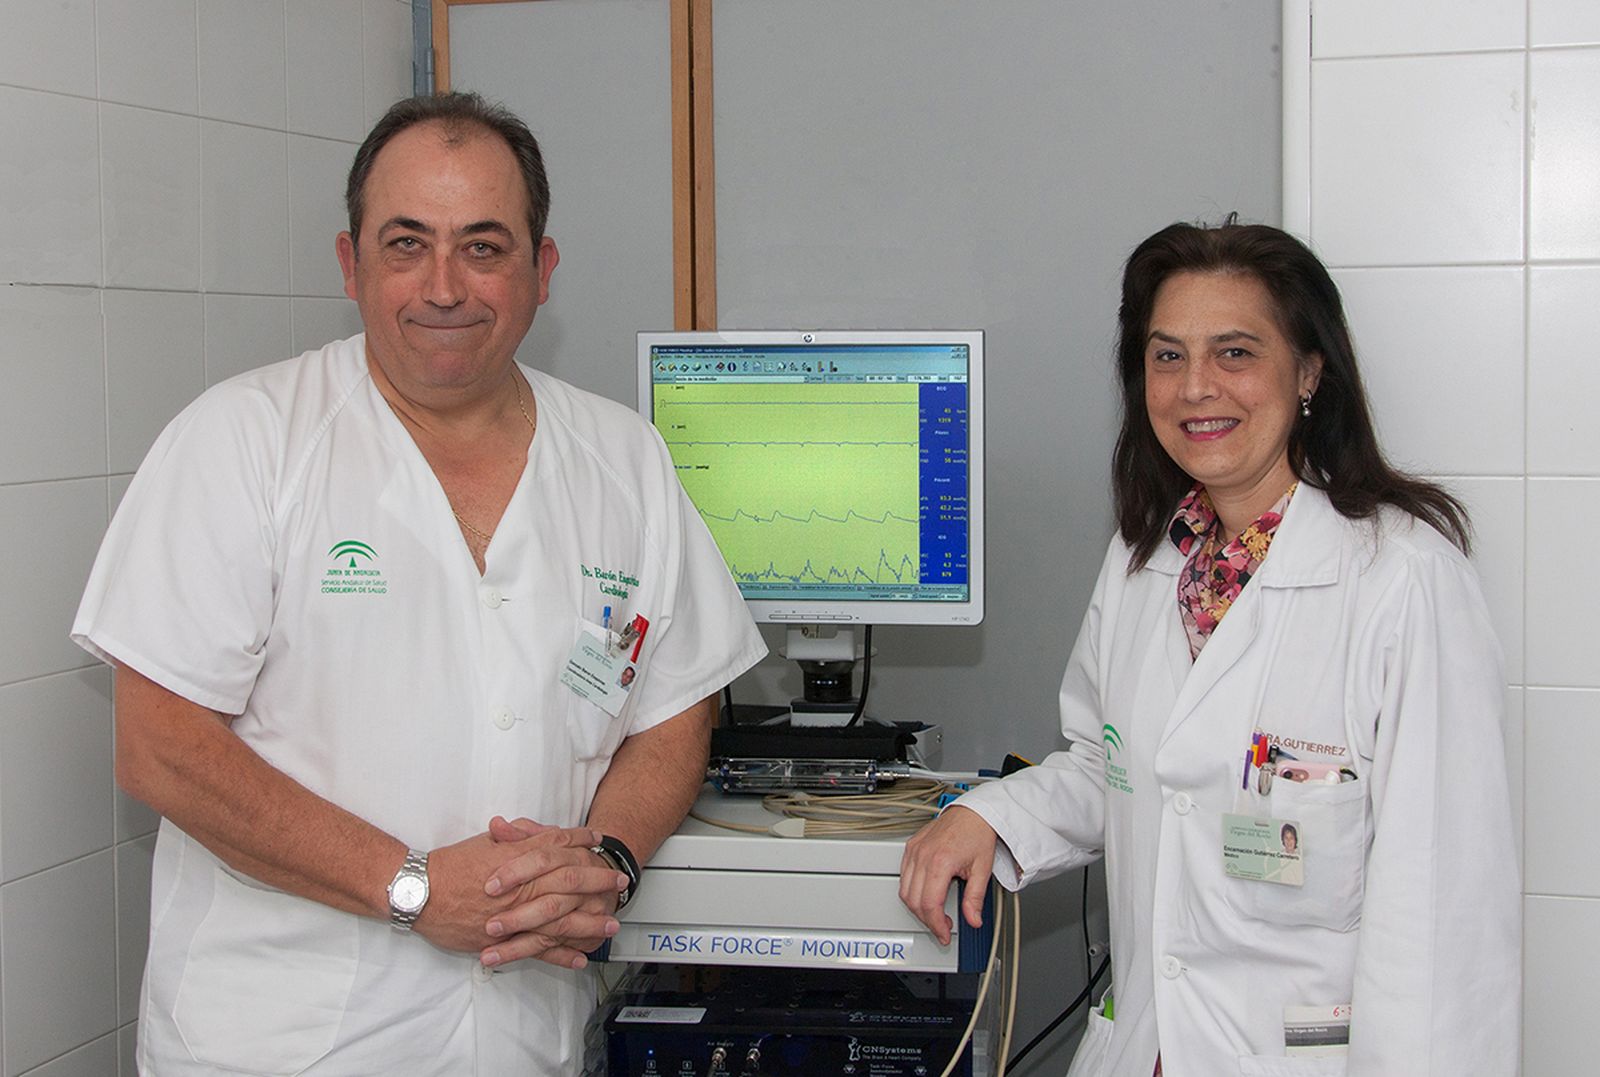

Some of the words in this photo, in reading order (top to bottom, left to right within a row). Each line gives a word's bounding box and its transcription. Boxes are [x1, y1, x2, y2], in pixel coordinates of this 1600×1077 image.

[1263, 732, 1346, 757] RA.GUTIERREZ
[648, 934, 704, 953] TASK
[801, 940, 905, 960] MONITOR
[862, 1045, 922, 1055] CNSystems
